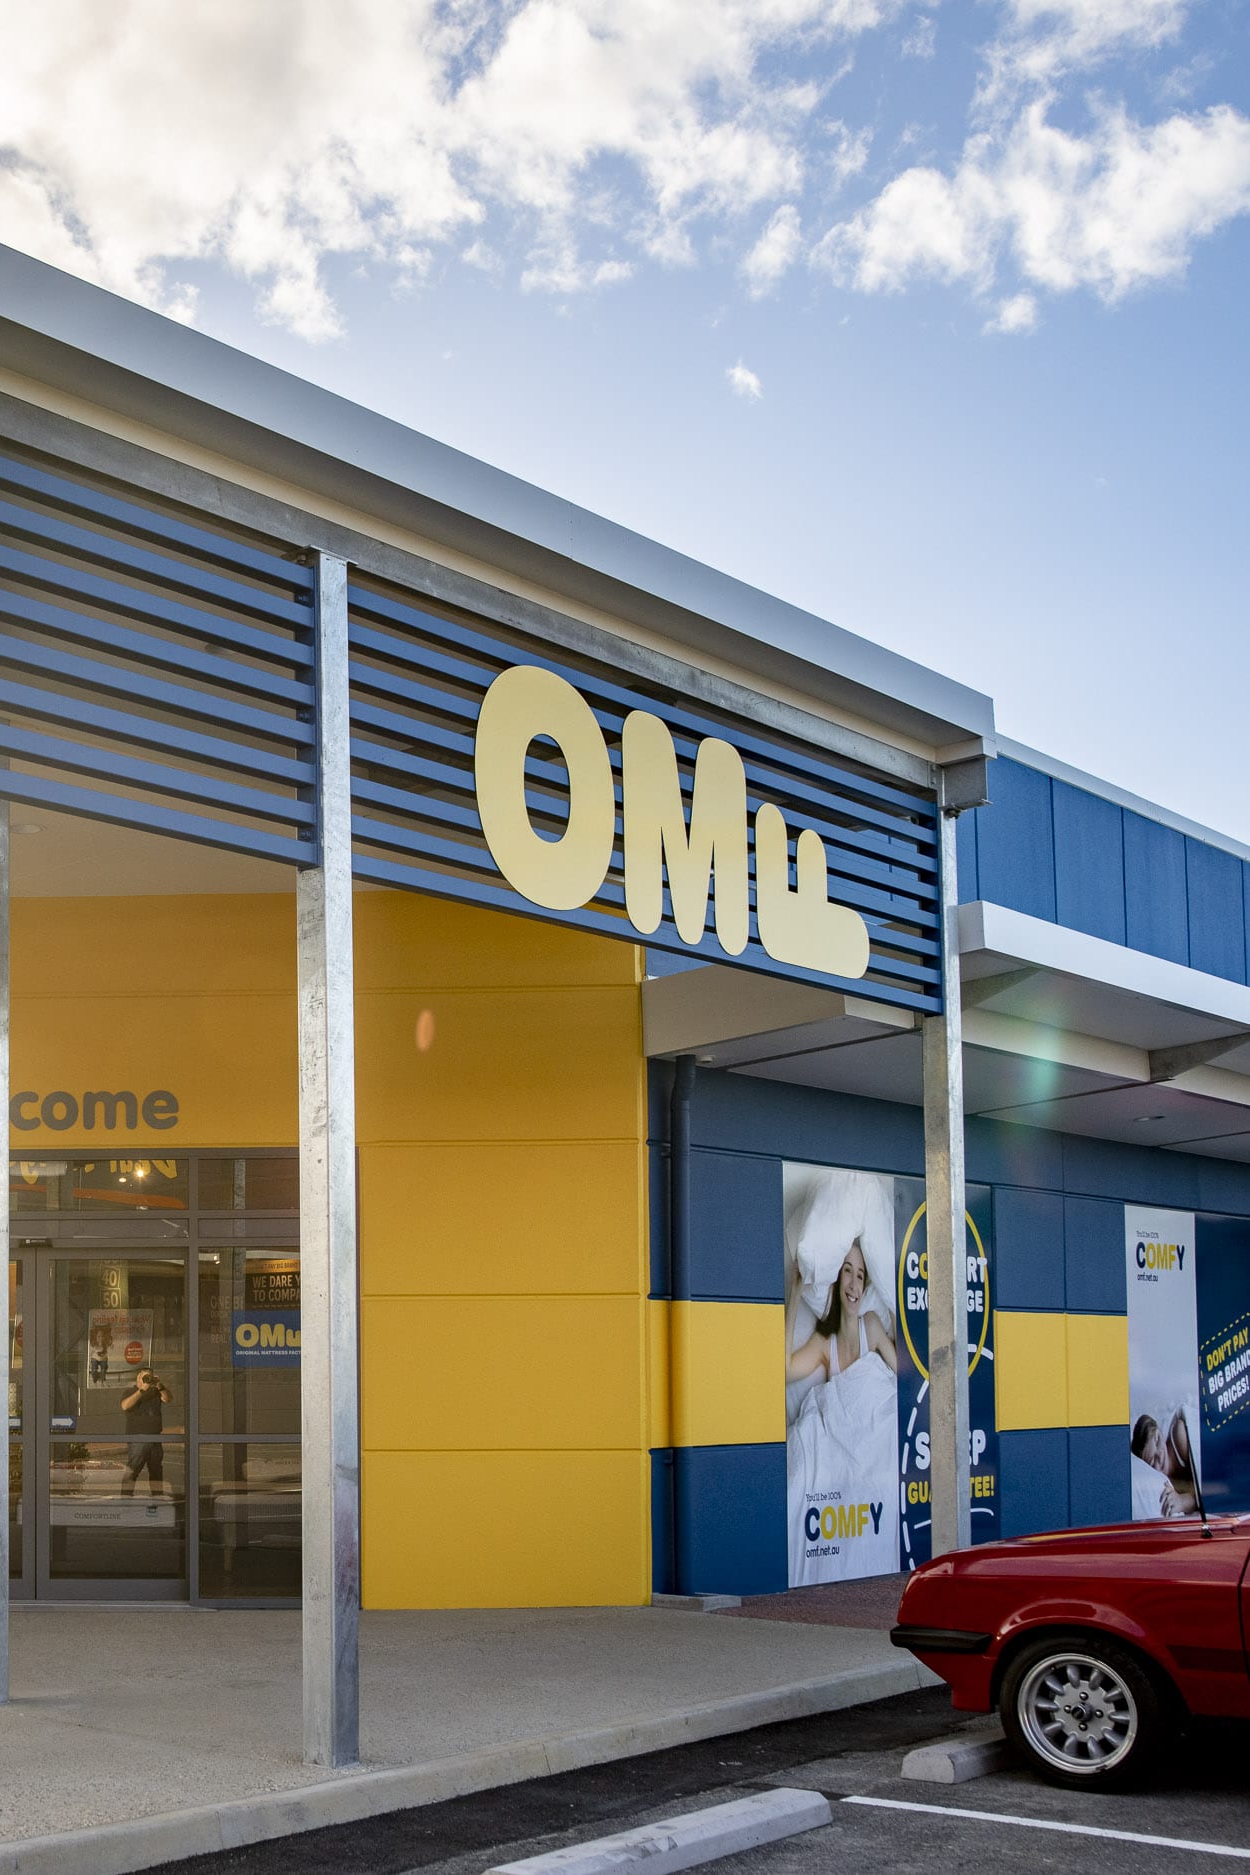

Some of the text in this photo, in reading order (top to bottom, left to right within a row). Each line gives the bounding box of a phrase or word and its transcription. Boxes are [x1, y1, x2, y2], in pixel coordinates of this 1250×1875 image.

[906, 1252, 988, 1283] CORT
[1136, 1241, 1185, 1271] COMFY
[102, 1270, 117, 1287] 40
[252, 1276, 267, 1288] WE
[270, 1275, 293, 1288] DARE
[103, 1291, 119, 1307] 50
[253, 1289, 301, 1302] TO COMPA
[907, 1287, 984, 1312] EXGE
[1206, 1326, 1249, 1372] DON'T PAY
[1208, 1370, 1224, 1395] BIG
[1217, 1375, 1250, 1413] PRICES!
[820, 1492, 827, 1501] be
[828, 1491, 842, 1500] 100%
[907, 1475, 995, 1504] GUTEE!
[805, 1502, 883, 1542] COMFY
[806, 1545, 840, 1558] omf.net.au
